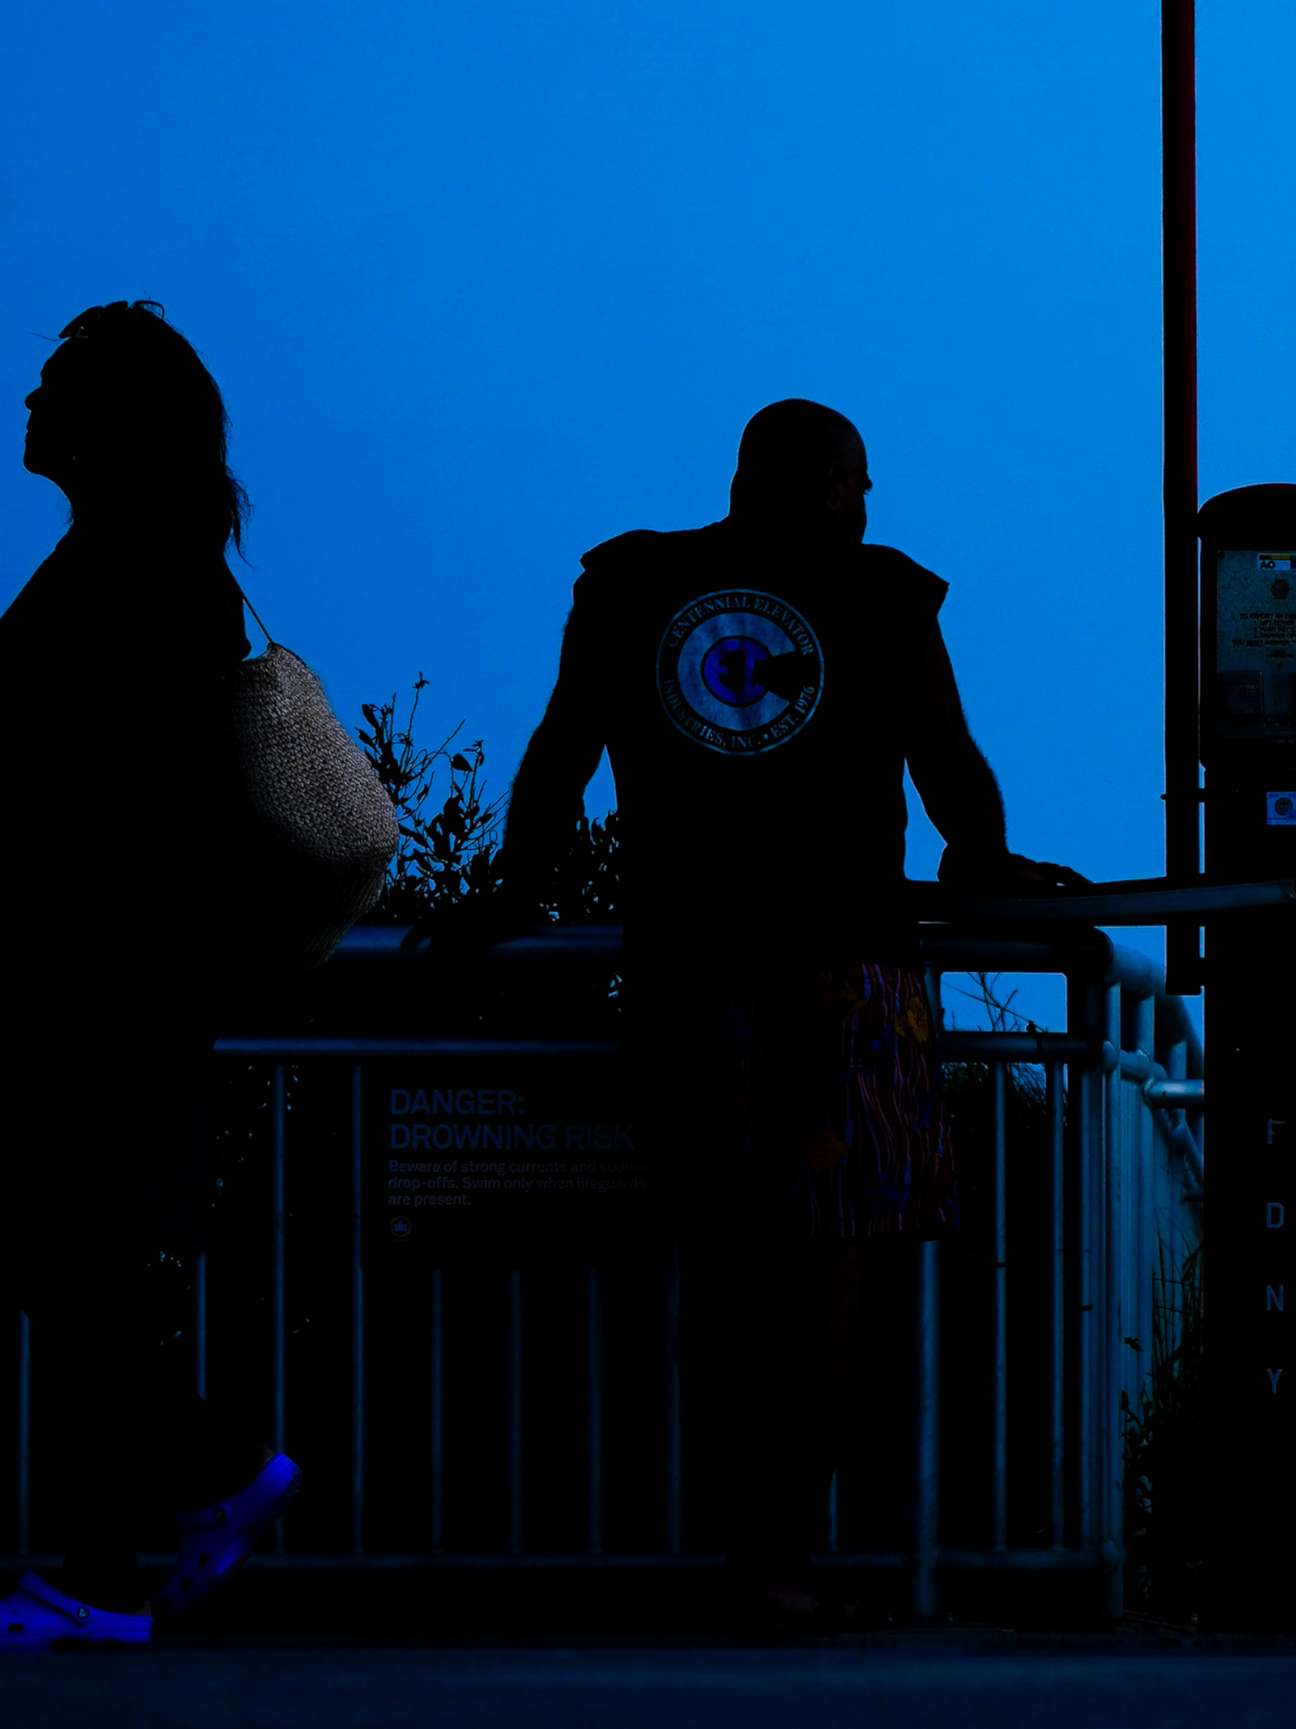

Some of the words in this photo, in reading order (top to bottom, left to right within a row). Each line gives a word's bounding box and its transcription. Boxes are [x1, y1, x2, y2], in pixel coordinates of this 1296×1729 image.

[668, 596, 751, 648] CENTENNIAL
[754, 597, 814, 656] ELEVATOR
[769, 713, 800, 739] EST.
[389, 1088, 527, 1116] DANGER:
[389, 1122, 559, 1152] DROWNING
[564, 1121, 635, 1152] RISK
[388, 1160, 440, 1173] Beware
[442, 1159, 458, 1173] of
[460, 1160, 507, 1176] strong
[508, 1160, 567, 1174] currents
[387, 1176, 459, 1191] drop-offs.
[461, 1176, 501, 1189] Swim
[503, 1176, 532, 1191] only
[533, 1177, 574, 1189] when
[387, 1195, 410, 1206] are
[414, 1194, 473, 1208] present.
[1264, 1118, 1288, 1395] FDNY
